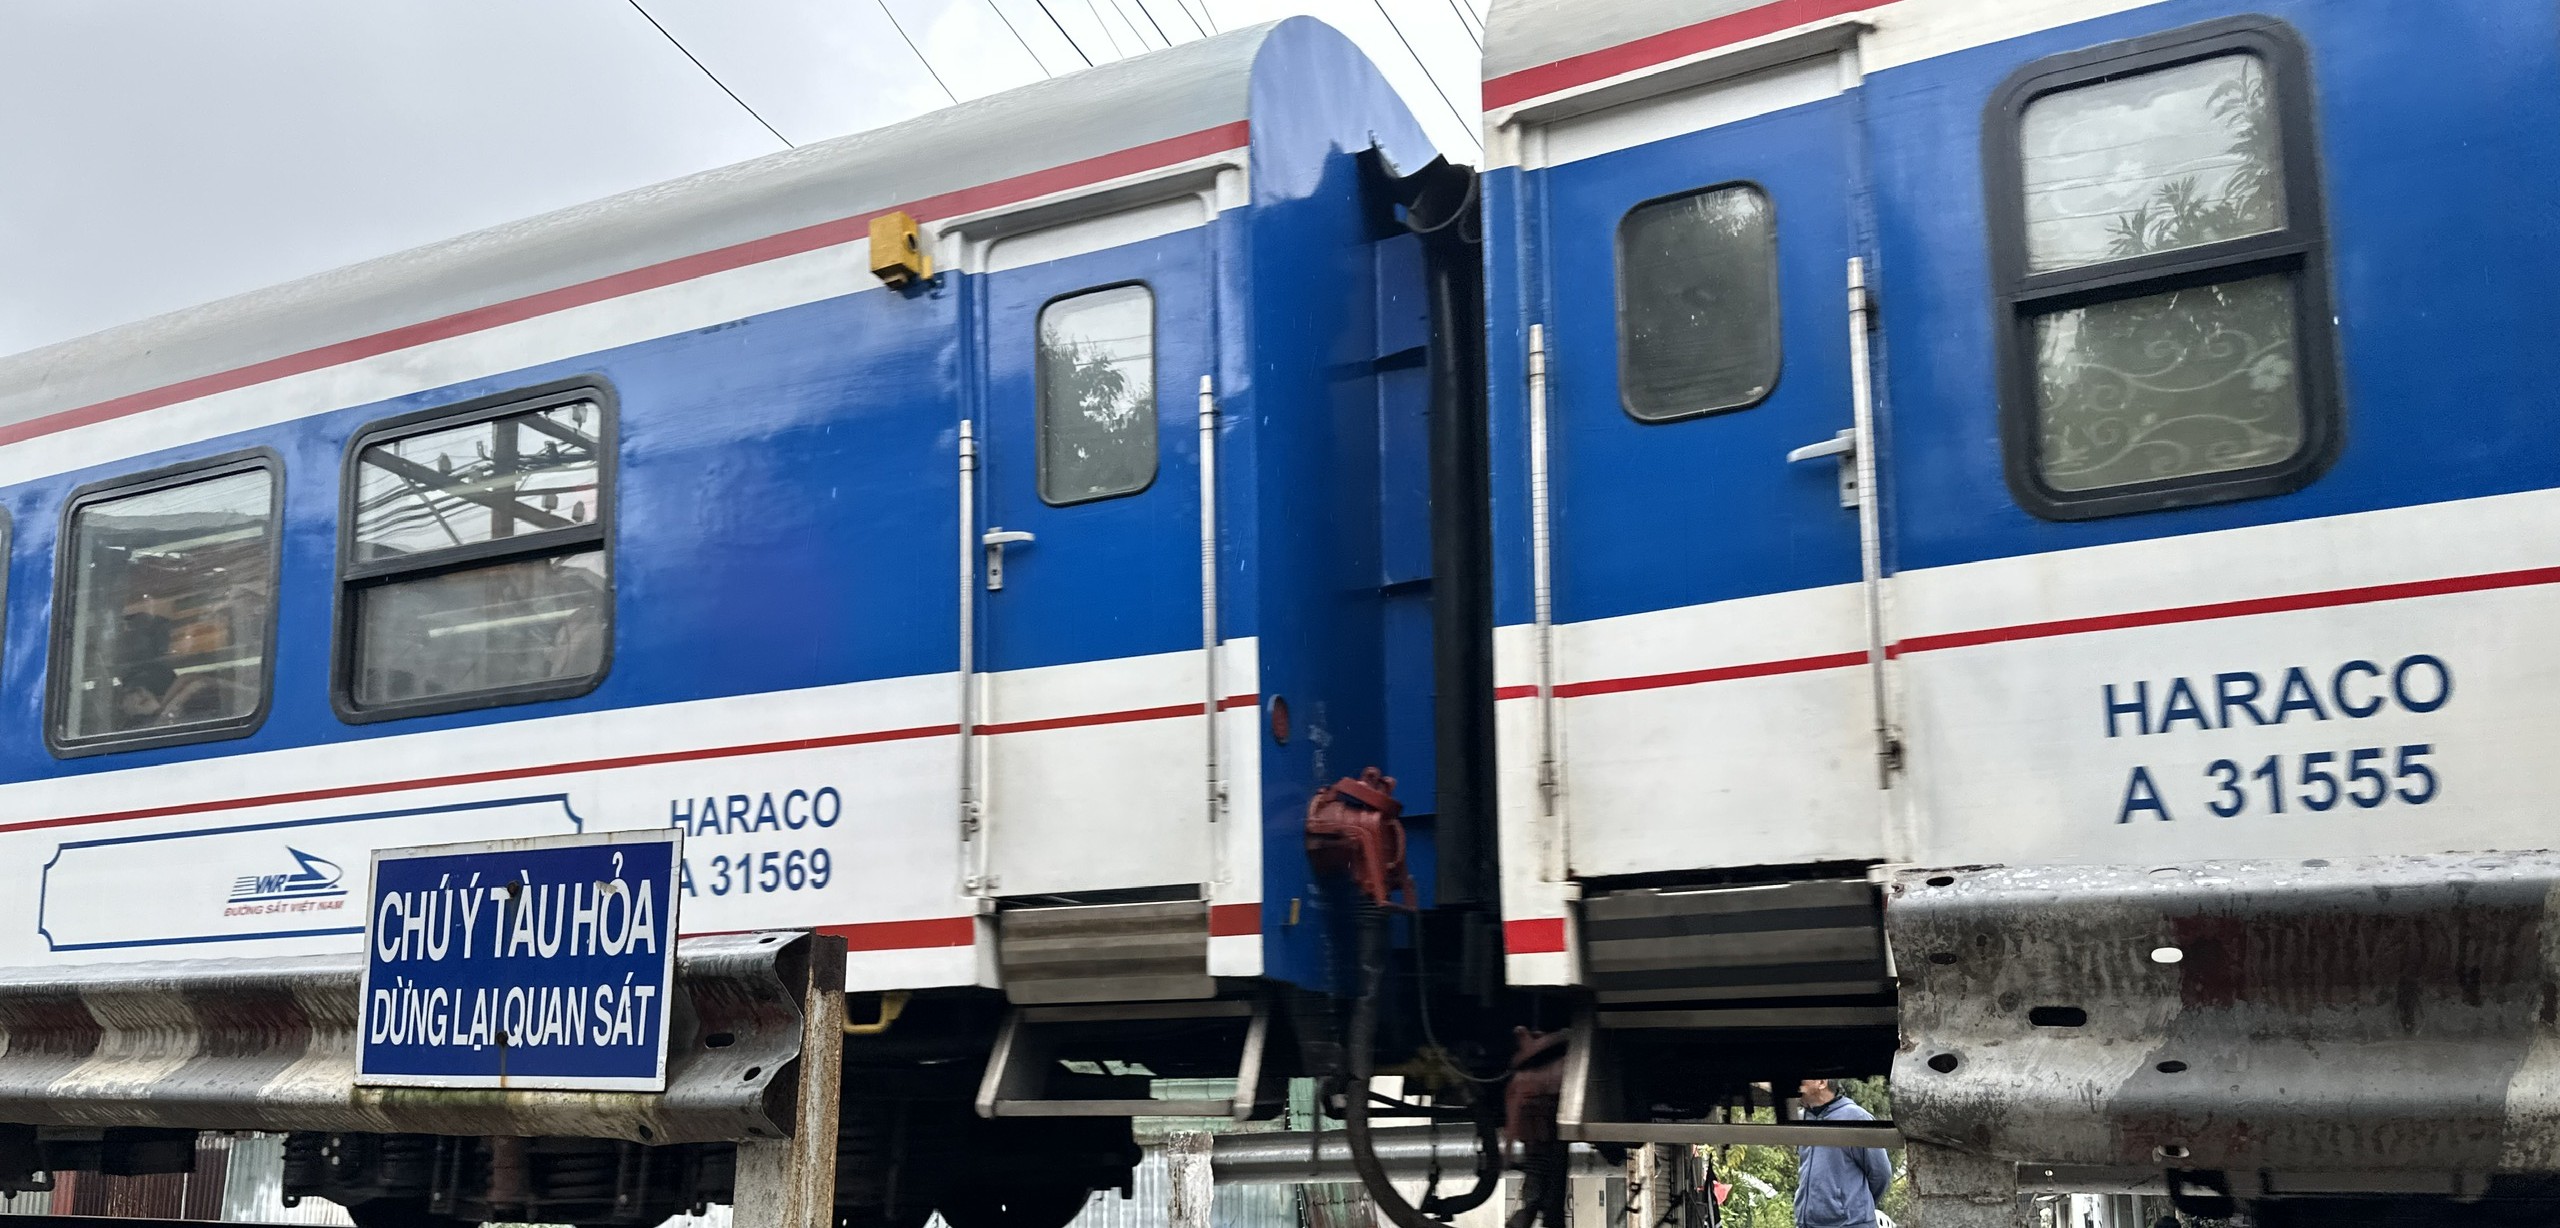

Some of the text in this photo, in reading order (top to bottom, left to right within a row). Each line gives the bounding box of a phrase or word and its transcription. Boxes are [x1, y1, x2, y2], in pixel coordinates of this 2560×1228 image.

[2101, 654, 2454, 738] HARACO
[671, 786, 841, 837] HARACO
[2115, 743, 2442, 824] A 31555
[255, 874, 287, 894] VNR
[710, 848, 831, 896] 31569
[265, 900, 288, 914] SÁT
[318, 900, 344, 910] NAM
[377, 851, 656, 963] CHÚ Ý TÀU HỎA
[371, 972, 655, 1051] DỪNG LẠI QUAN SÁT
